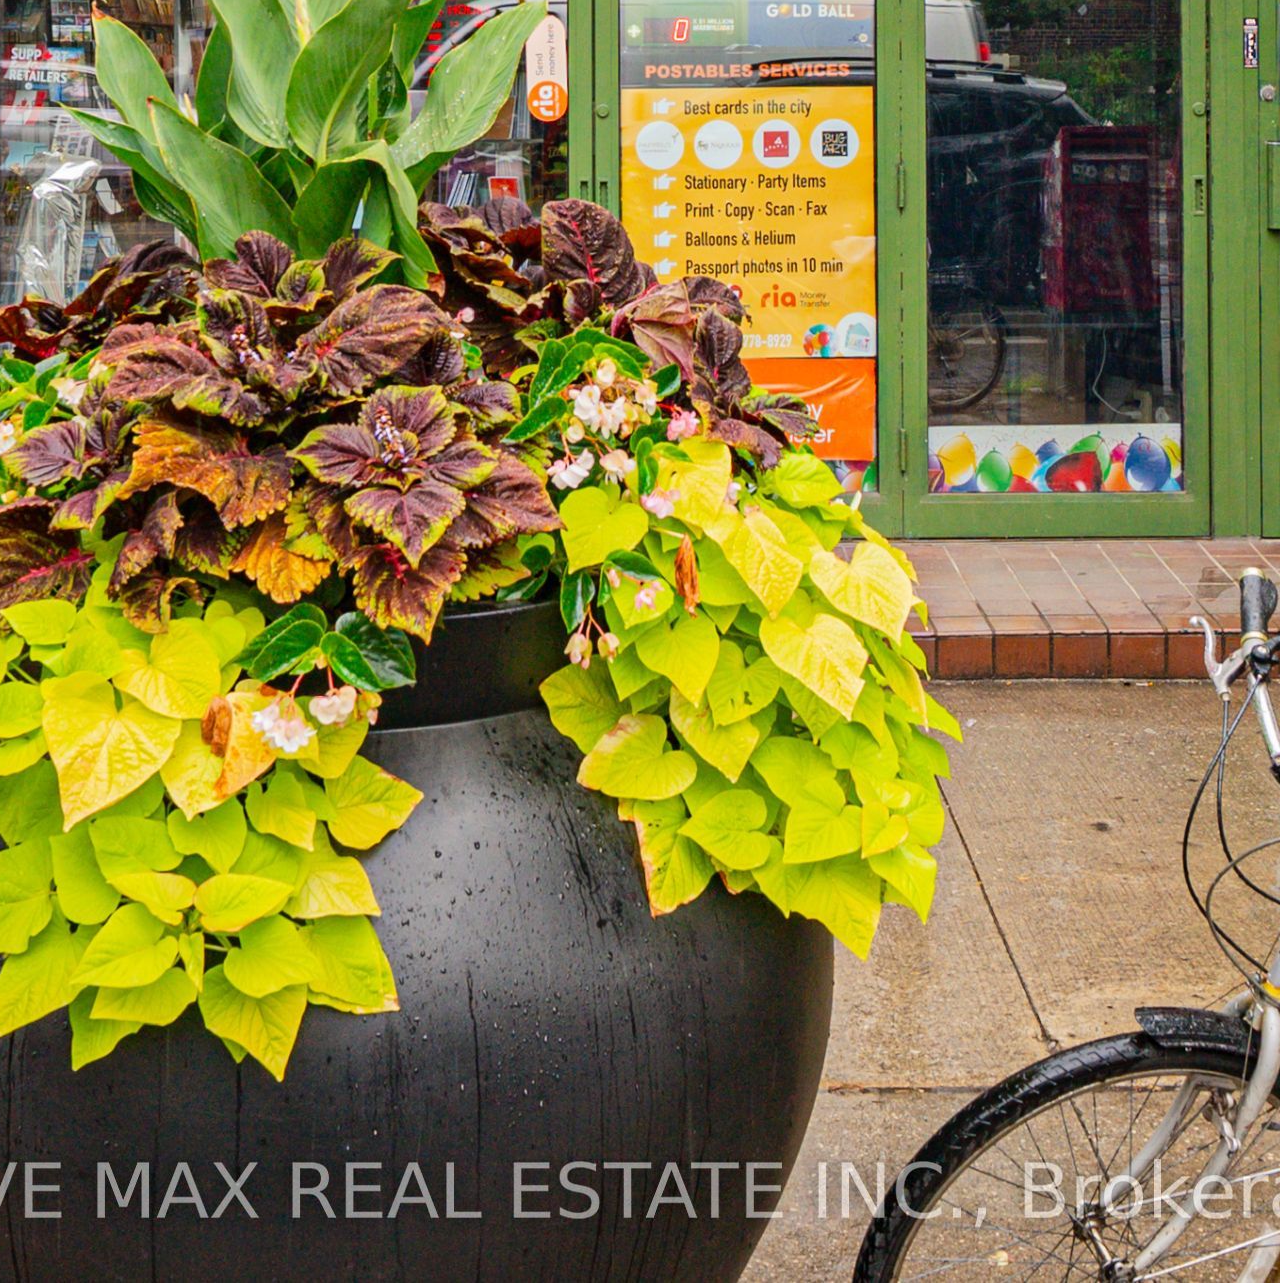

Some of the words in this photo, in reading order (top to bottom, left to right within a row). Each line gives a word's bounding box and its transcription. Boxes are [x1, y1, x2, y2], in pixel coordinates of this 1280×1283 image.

[818, 4, 855, 18] BALL
[535, 53, 543, 76] Send
[549, 39, 557, 76] money
[9, 69, 68, 84] RETAILERS
[645, 64, 753, 79] POSTABLES
[758, 62, 850, 77] SERVICES
[538, 84, 554, 116] ria
[684, 100, 710, 115] Best
[715, 99, 749, 115] cards
[753, 99, 764, 114] in
[767, 100, 786, 114] the
[790, 99, 812, 118] city
[824, 134, 846, 144] BUG
[824, 145, 847, 156] ART
[685, 174, 747, 193] Stationary
[758, 174, 789, 192] Party
[792, 173, 826, 188] Items
[685, 202, 715, 218] Print
[725, 201, 755, 220] Copy
[765, 201, 795, 216] Scan
[806, 200, 828, 216] Fax
[685, 231, 738, 247] Balloons
[741, 232, 750, 246] &
[754, 230, 796, 246] Helium
[686, 259, 740, 276] Passport
[743, 259, 783, 277] photos
[786, 259, 798, 273] in
[802, 258, 817, 273] 10
[820, 258, 843, 273] min
[761, 284, 797, 308] ria
